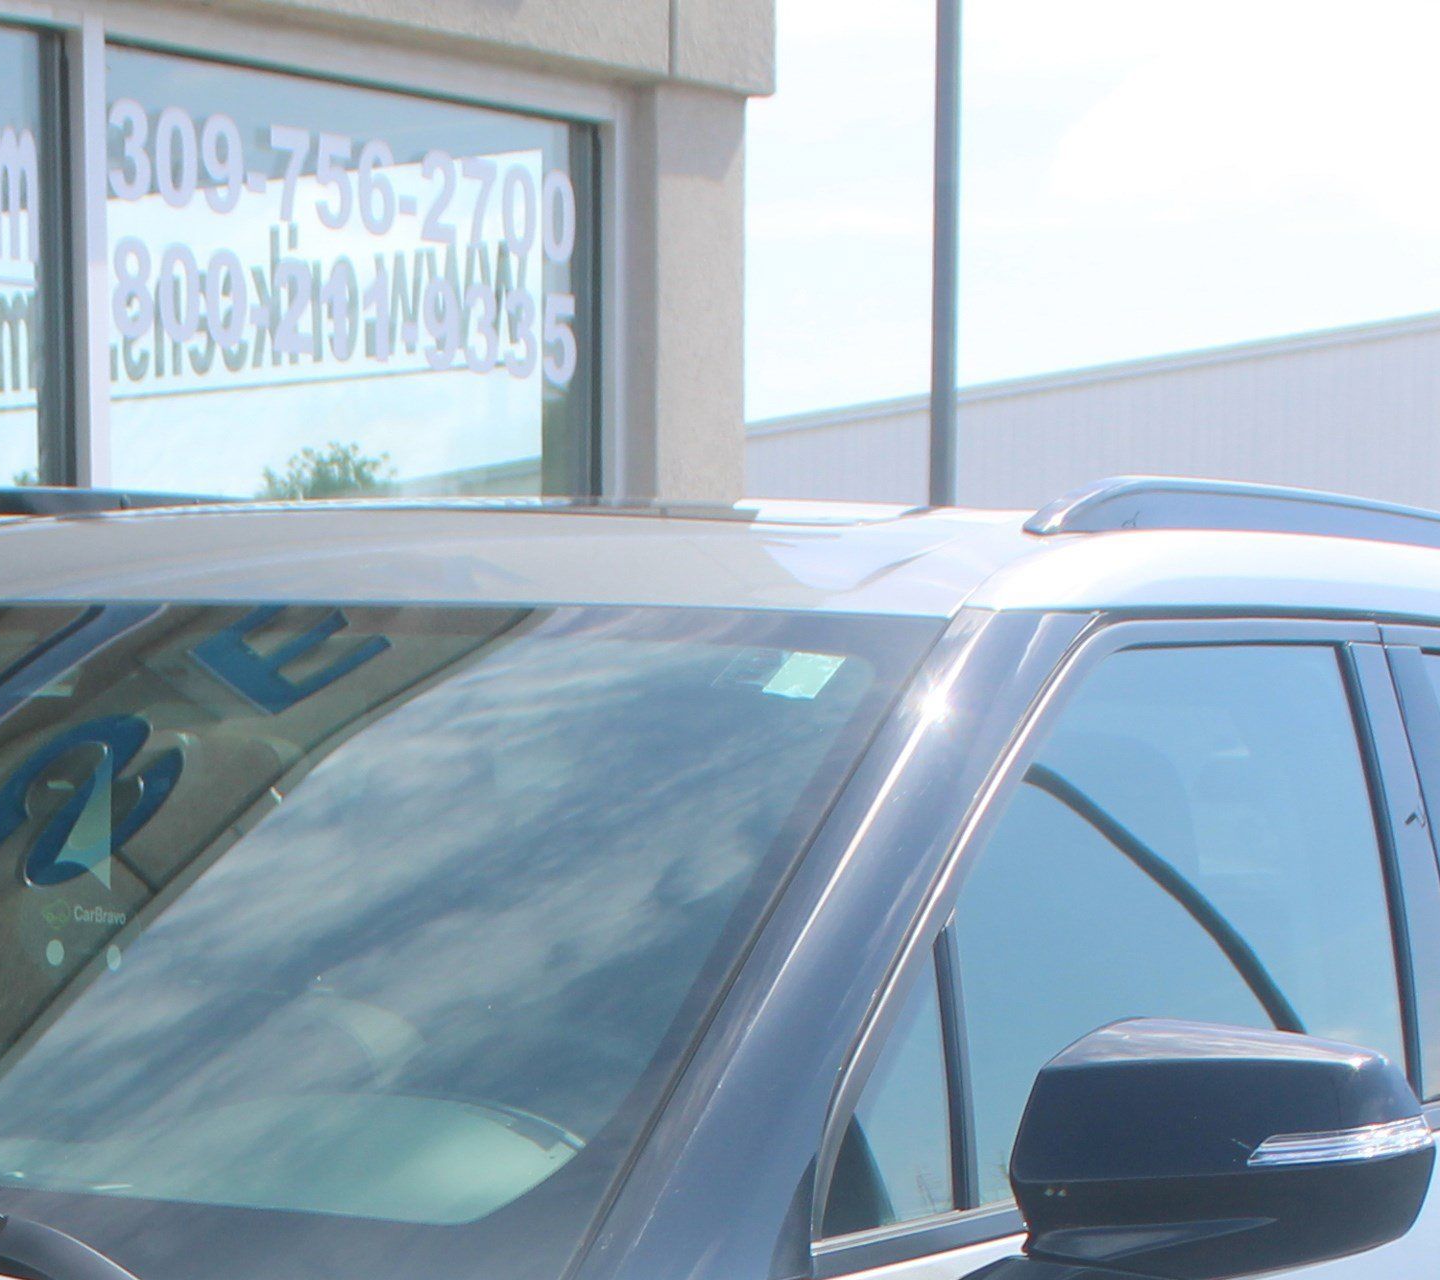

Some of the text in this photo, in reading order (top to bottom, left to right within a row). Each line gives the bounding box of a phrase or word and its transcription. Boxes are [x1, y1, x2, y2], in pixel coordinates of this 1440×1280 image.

[108, 98, 576, 262] 309-756-2700
[114, 235, 577, 386] 800-211-9335
[73, 905, 126, 925] CarBravo
